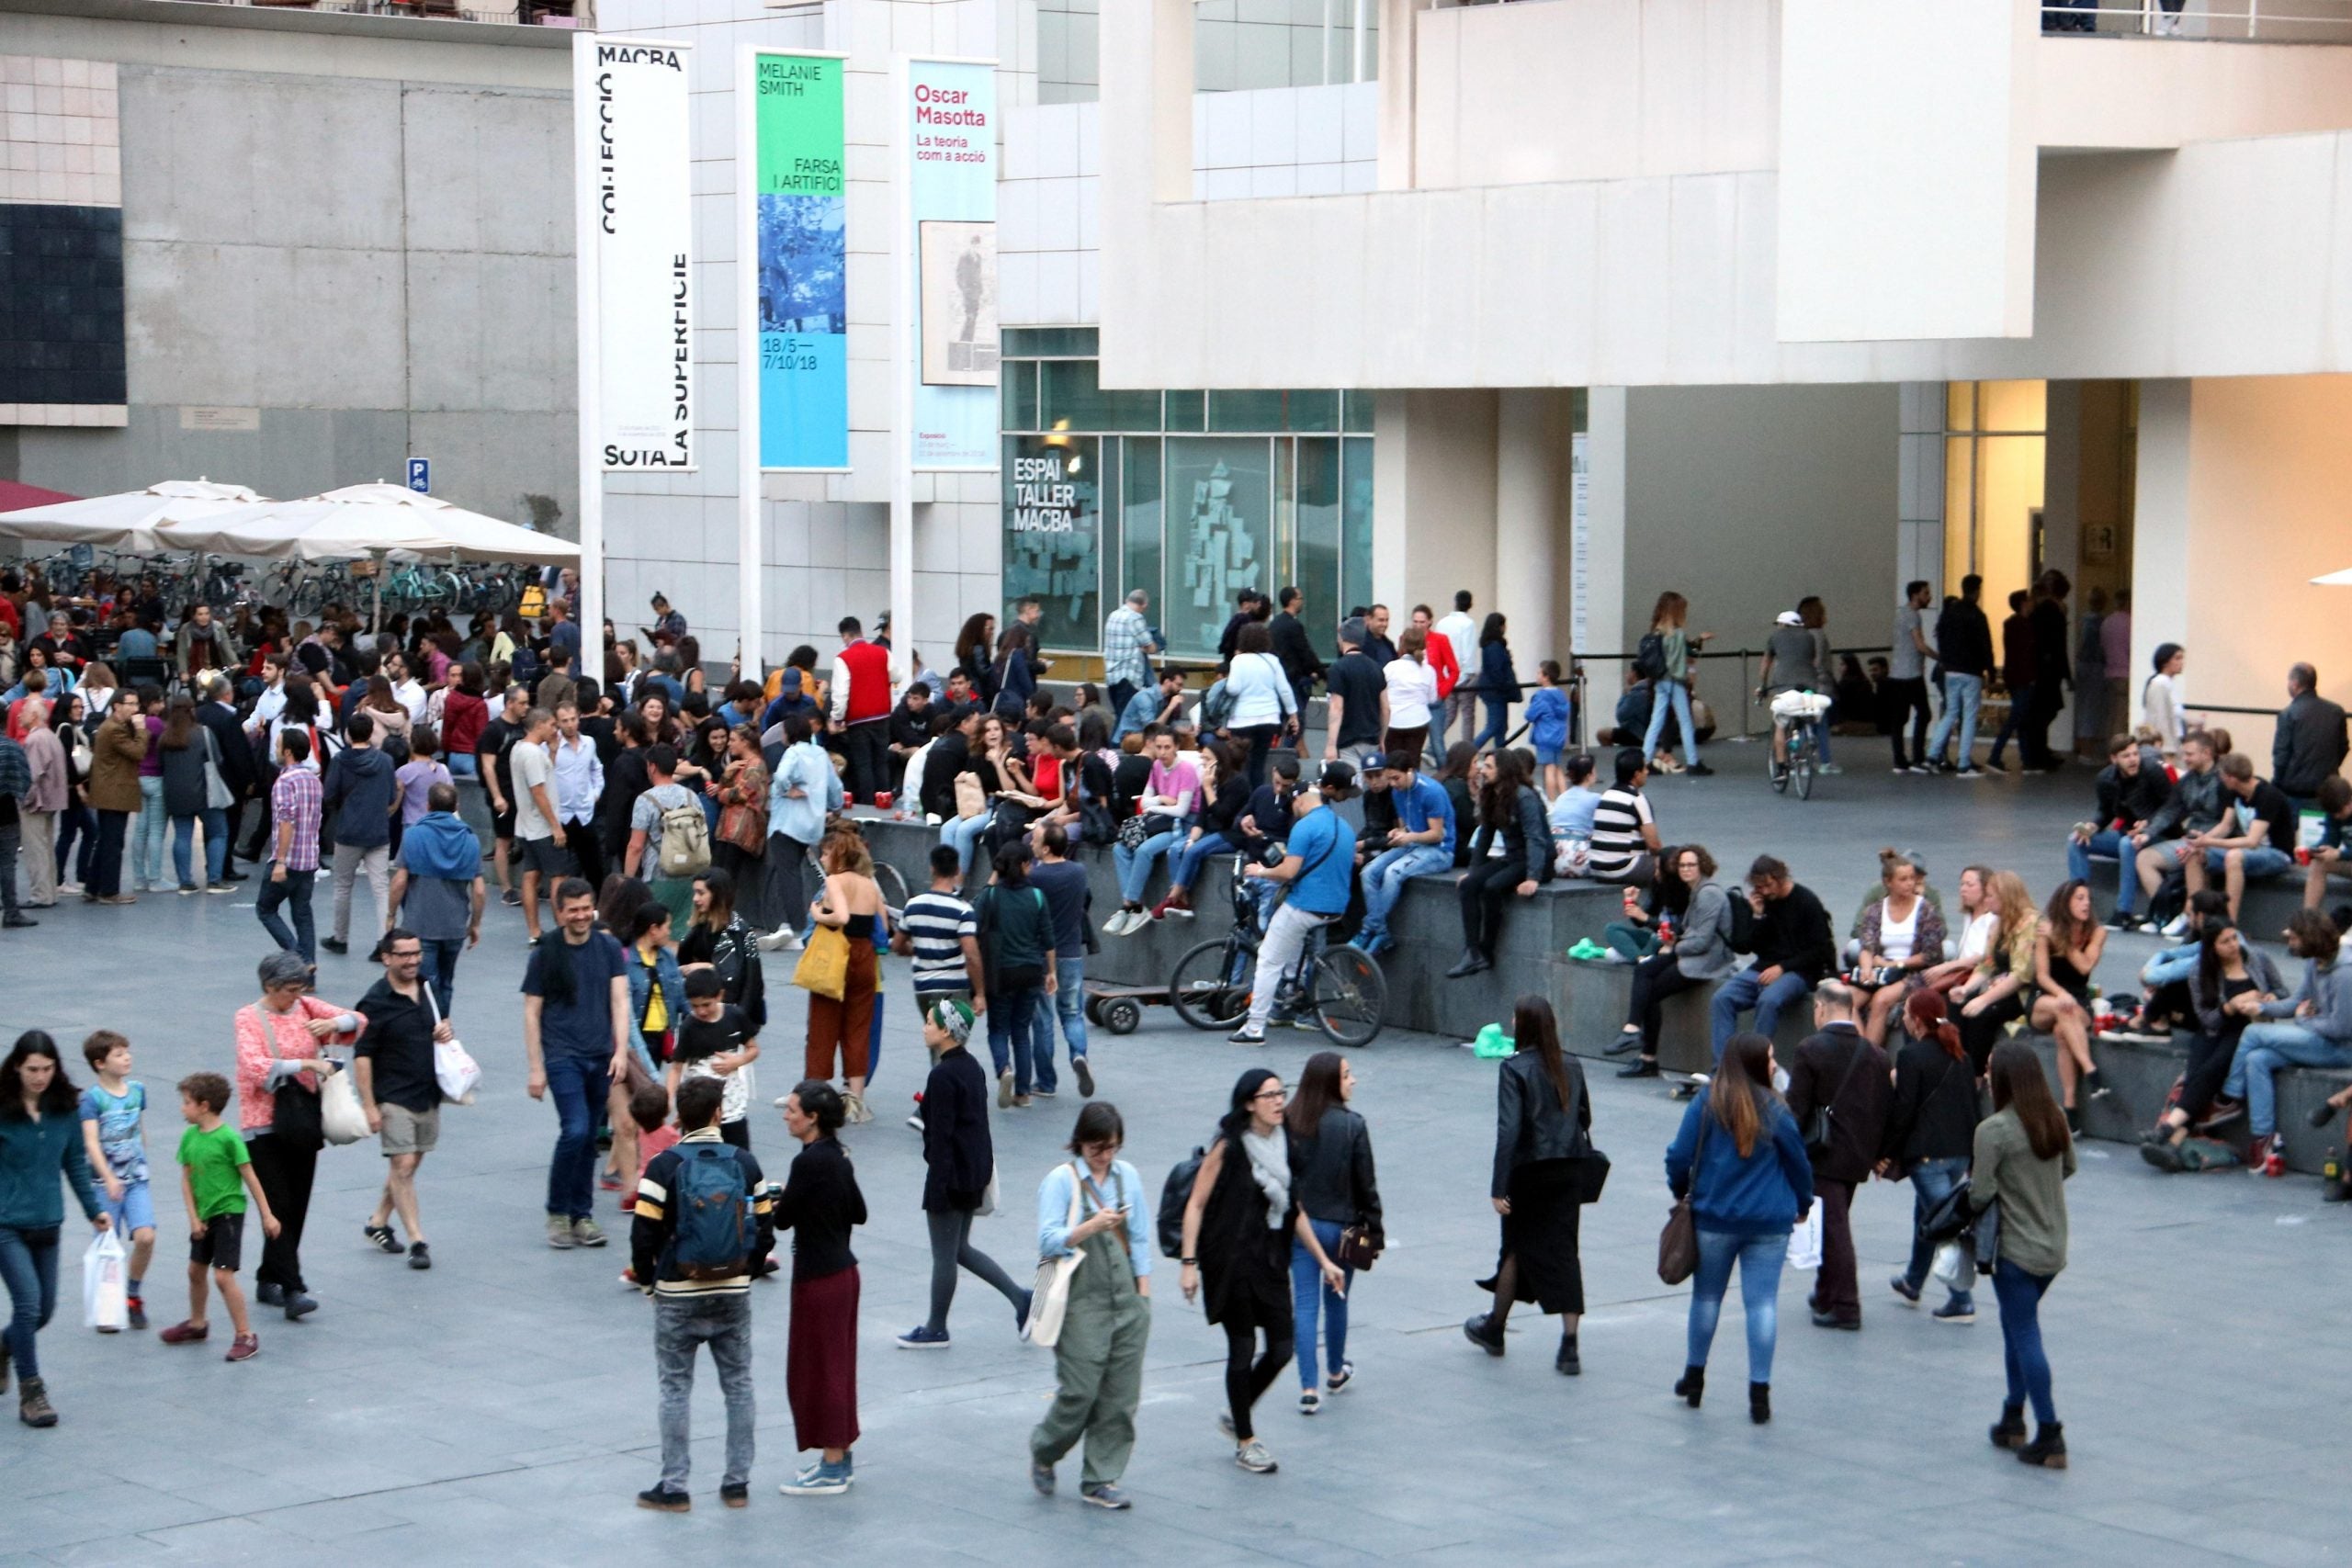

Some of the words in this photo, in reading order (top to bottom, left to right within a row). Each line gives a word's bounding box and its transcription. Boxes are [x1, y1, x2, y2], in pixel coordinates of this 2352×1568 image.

[598, 45, 682, 72] MACBA
[759, 62, 821, 81] MELANIE
[759, 80, 804, 96] SMITH
[914, 84, 968, 104] Oscar
[916, 106, 986, 127] Masotta
[916, 133, 931, 147] La
[934, 135, 967, 148] teoria
[917, 151, 942, 161] com
[944, 152, 952, 161] a
[954, 150, 986, 163] acció
[795, 158, 841, 175] FARSA
[781, 175, 841, 191] ARTIFICI
[763, 355, 818, 370] 7/10/18
[669, 429, 687, 466] LA
[413, 463, 424, 477] P
[1013, 457, 1060, 481] ESPAI
[1013, 483, 1075, 507] TALLER
[1013, 508, 1074, 532] MACBA
